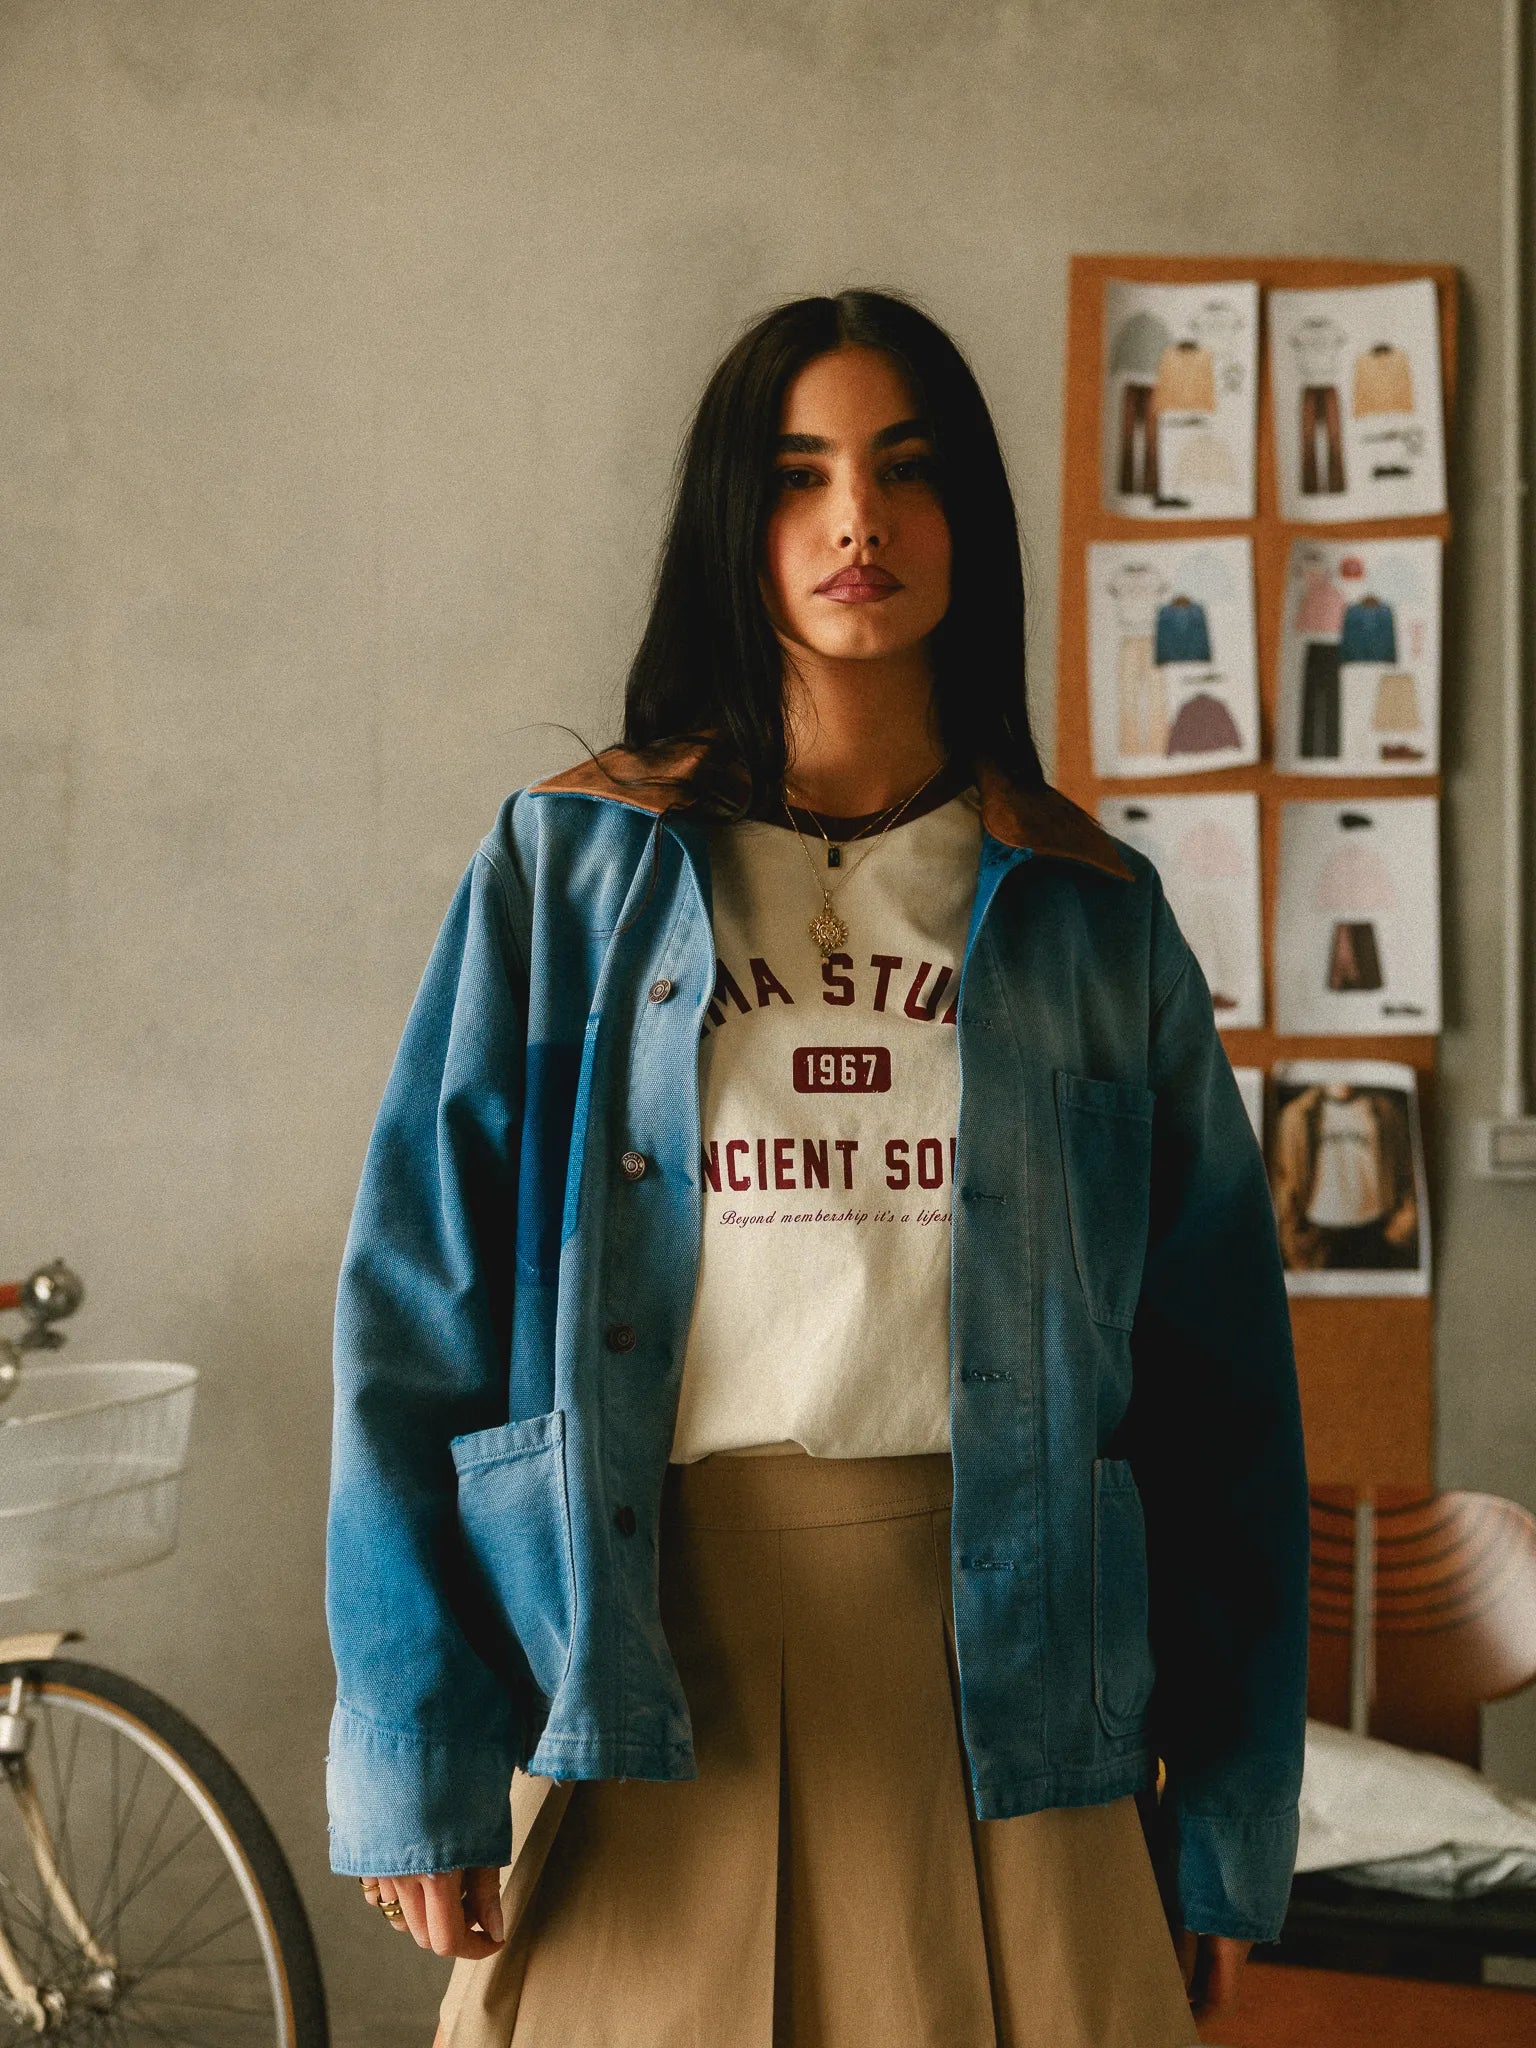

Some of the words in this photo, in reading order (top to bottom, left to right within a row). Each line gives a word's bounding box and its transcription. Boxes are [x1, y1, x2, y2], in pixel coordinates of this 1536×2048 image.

[700, 957, 795, 1039] MA
[821, 952, 959, 1025] STU
[806, 1053, 877, 1086] 1967
[885, 1138, 957, 1191] SO
[720, 1210, 775, 1229] Beyond
[780, 1208, 868, 1225] membership
[873, 1210, 895, 1223] it's
[901, 1214, 910, 1223] a
